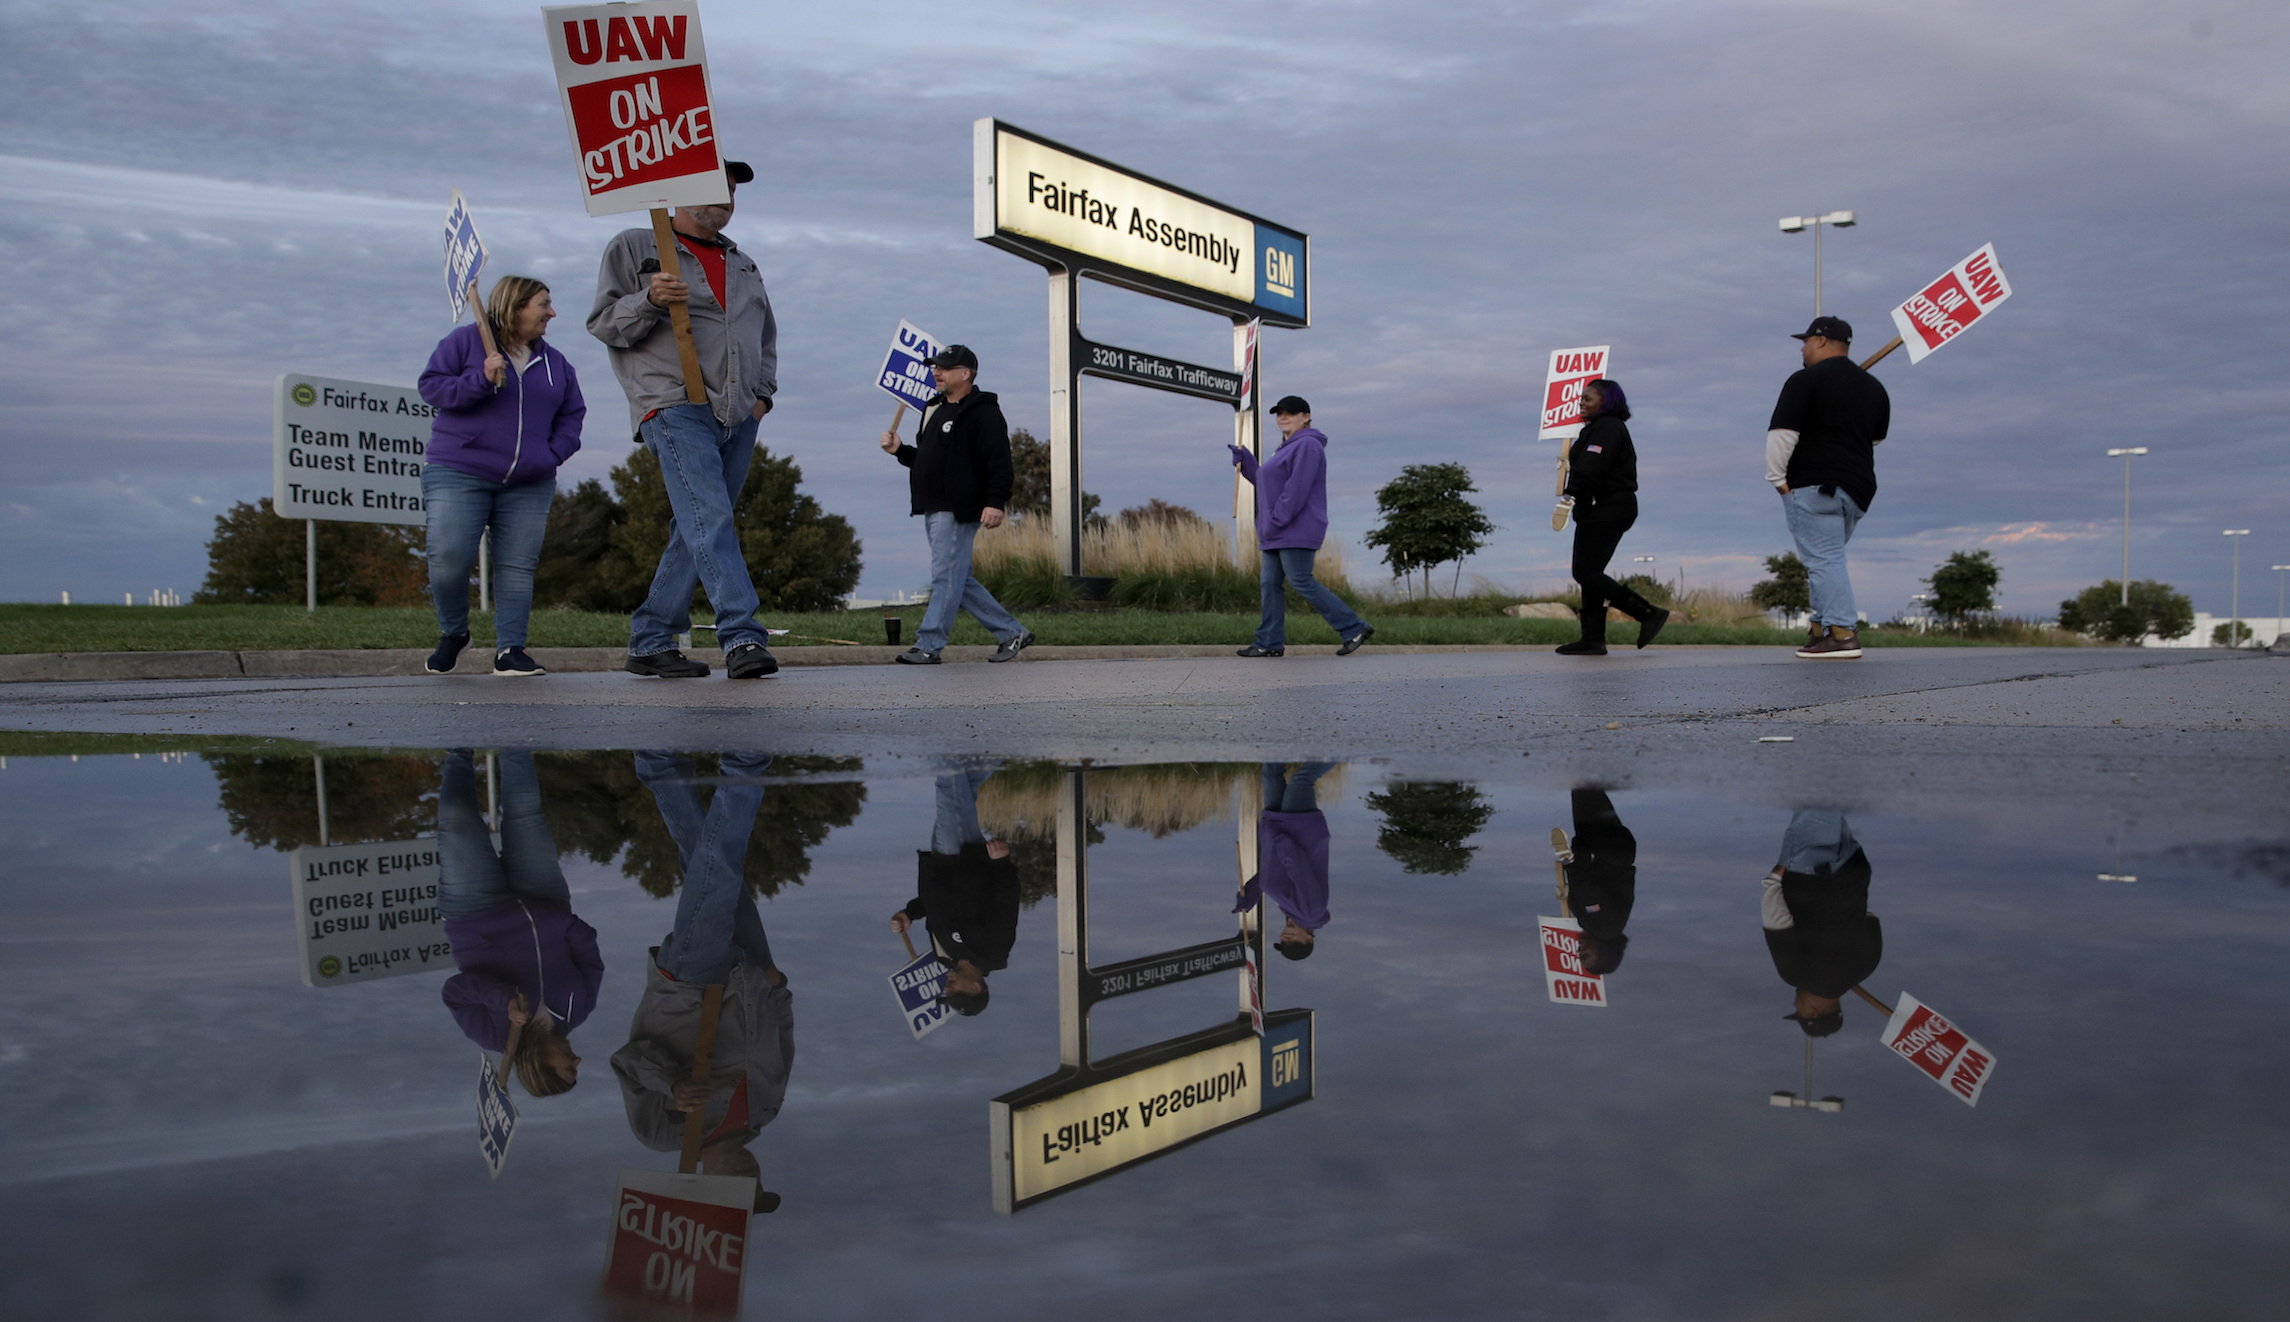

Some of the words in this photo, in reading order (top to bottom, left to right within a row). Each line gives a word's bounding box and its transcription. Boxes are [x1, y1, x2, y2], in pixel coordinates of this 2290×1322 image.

[563, 15, 687, 65] UAW
[609, 76, 663, 129] ON
[584, 106, 713, 190] STRIKE
[1028, 171, 1118, 230] Fairfax
[1128, 207, 1240, 273] Assembly
[1265, 247, 1294, 288] GM
[1964, 251, 2004, 305] UAW
[1904, 294, 1963, 339] STRIKE
[1937, 287, 1968, 313] ON
[905, 361, 930, 382] ON
[1092, 348, 1124, 369] 3201
[1129, 355, 1173, 379] Fairfax
[1176, 365, 1238, 395] Trafficway
[1556, 352, 1604, 373] UAW
[323, 387, 389, 413] Fairfax
[395, 397, 439, 418] Asse
[1561, 378, 1585, 402] ON
[288, 423, 349, 448] Team
[358, 431, 428, 455] Memb
[288, 448, 356, 472] Guest
[364, 455, 421, 477] Entra
[288, 483, 354, 507] Truck
